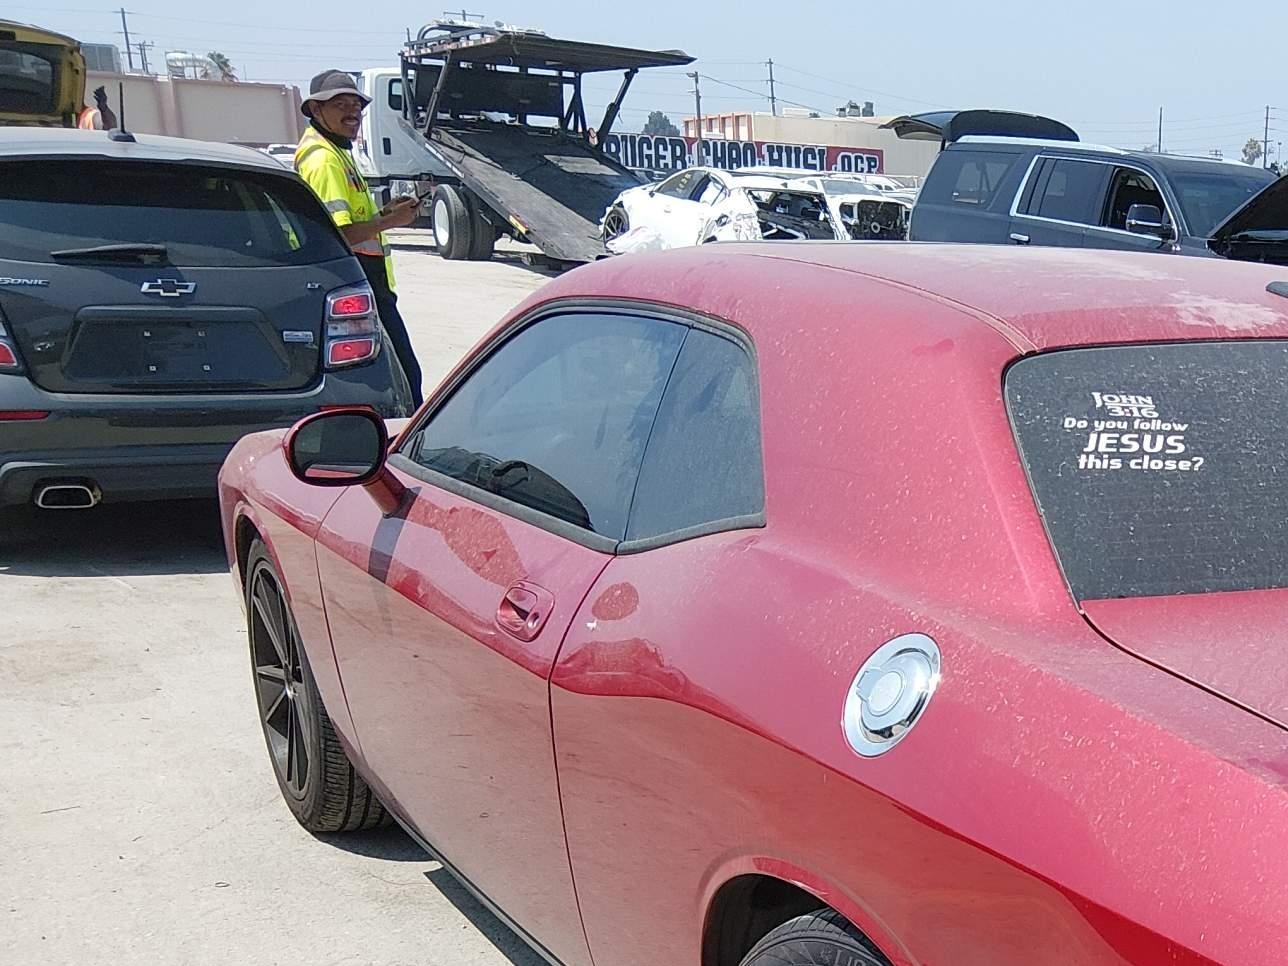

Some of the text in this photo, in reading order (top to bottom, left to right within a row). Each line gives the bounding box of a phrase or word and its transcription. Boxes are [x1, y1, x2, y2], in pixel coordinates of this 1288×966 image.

[1091, 392, 1154, 408] JOHN
[1107, 407, 1160, 418] 3:16
[1063, 417, 1189, 432] Do you follow
[1083, 432, 1186, 454] JESUS
[1078, 454, 1204, 471] this close?
